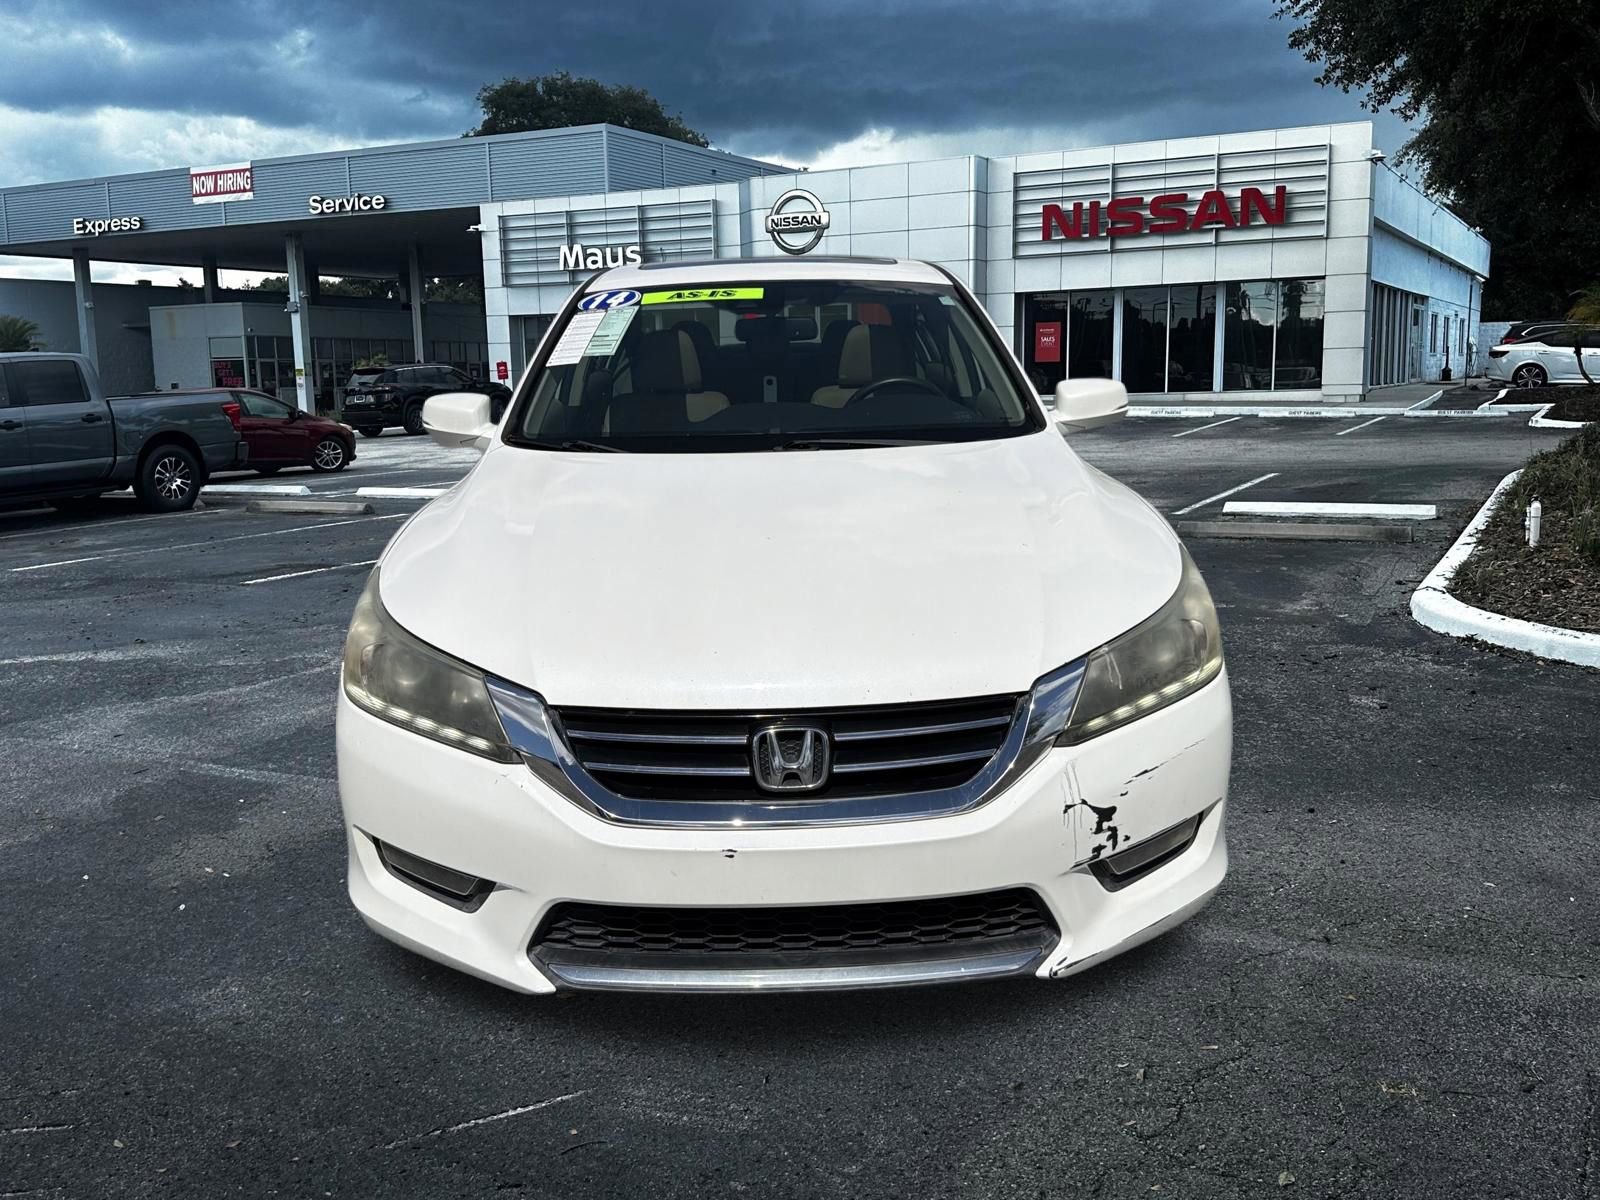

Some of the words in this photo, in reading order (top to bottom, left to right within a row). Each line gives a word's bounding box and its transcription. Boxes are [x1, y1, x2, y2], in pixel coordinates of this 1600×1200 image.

[193, 175, 215, 195] NOW
[217, 171, 251, 192] HIRING
[309, 192, 385, 214] Service
[1042, 185, 1287, 241] NISSAN
[73, 216, 141, 236] Express
[770, 215, 822, 228] NISSAN
[559, 243, 642, 270] Maus
[588, 291, 630, 308] 14
